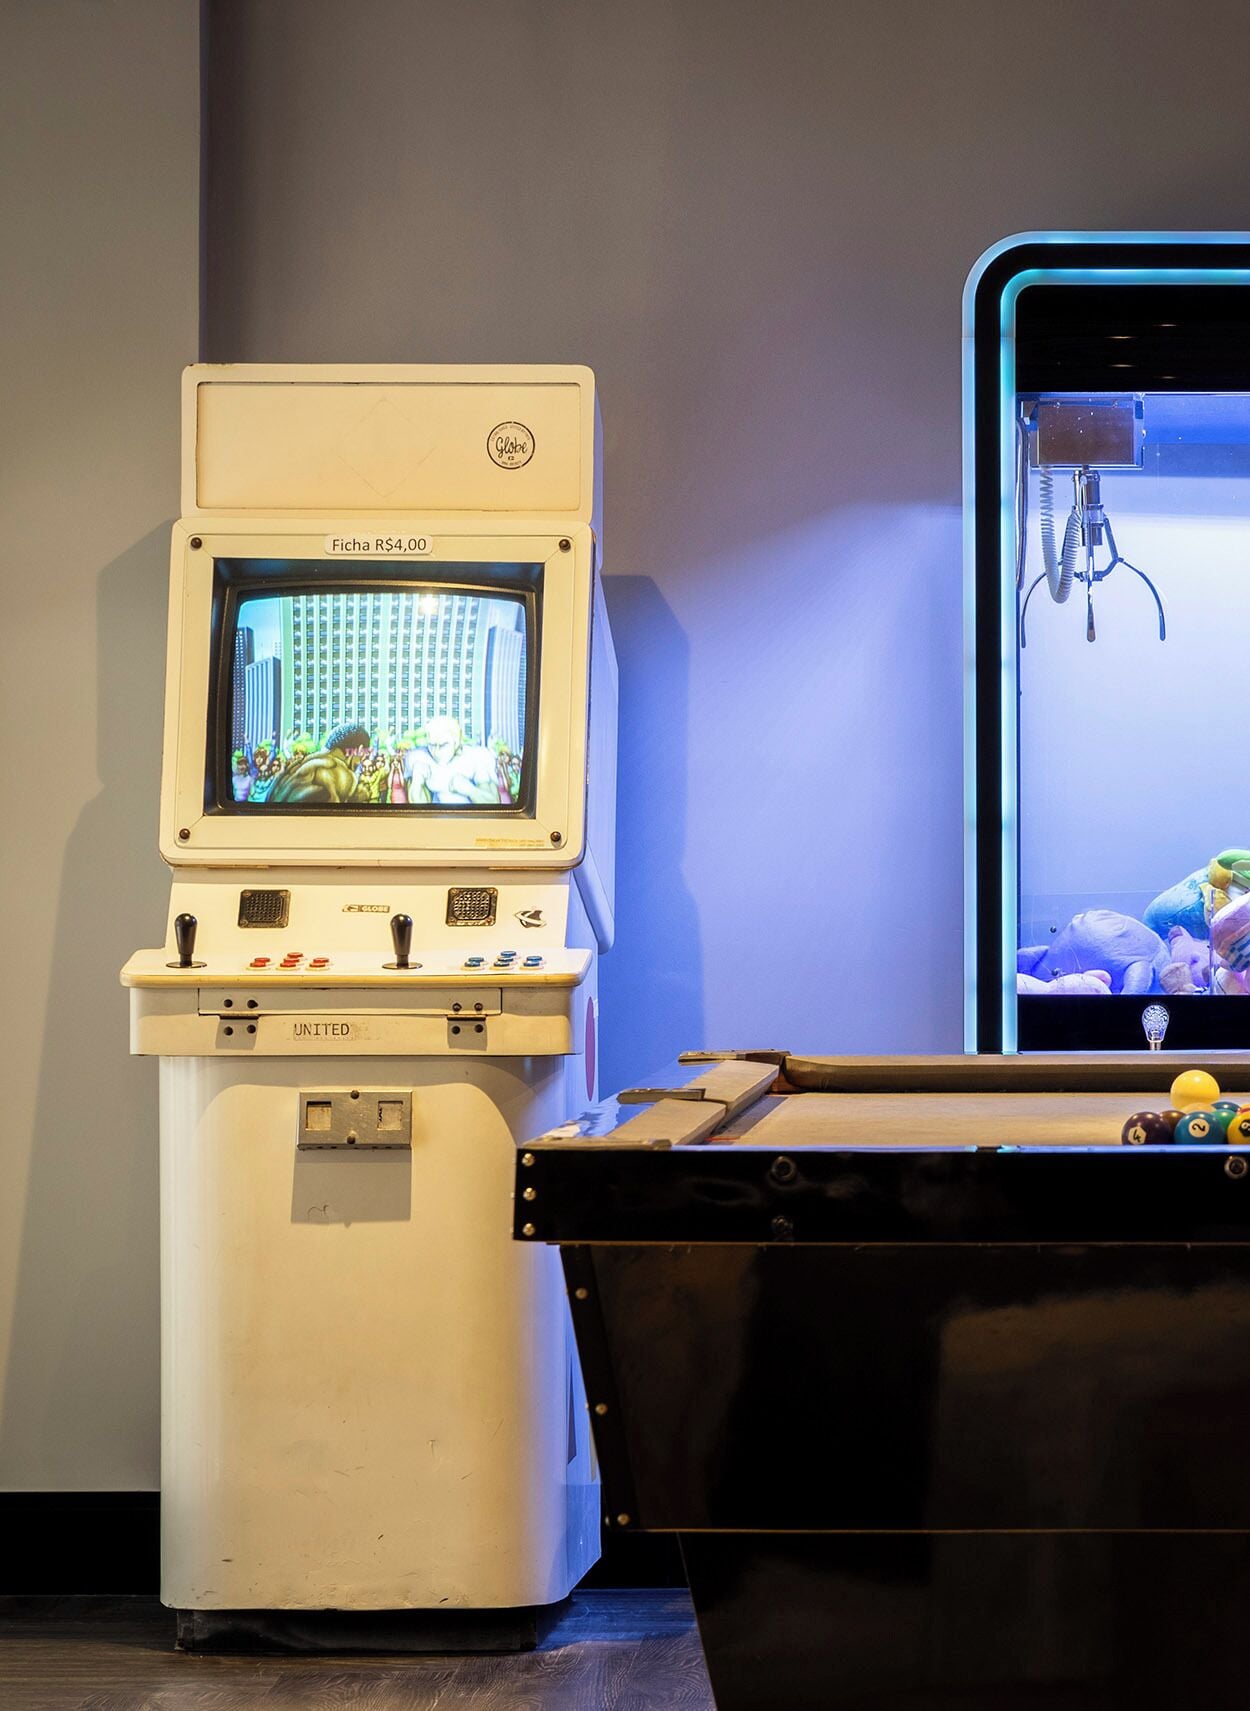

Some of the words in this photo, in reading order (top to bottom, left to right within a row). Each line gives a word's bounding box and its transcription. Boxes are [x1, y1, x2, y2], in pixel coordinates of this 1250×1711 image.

[495, 436, 528, 459] Globe
[332, 538, 370, 552] Ficha
[375, 537, 427, 553] R$4,00
[294, 1023, 350, 1036] UNITED
[1191, 1122, 1206, 1132] 2
[1132, 1129, 1142, 1143] 4
